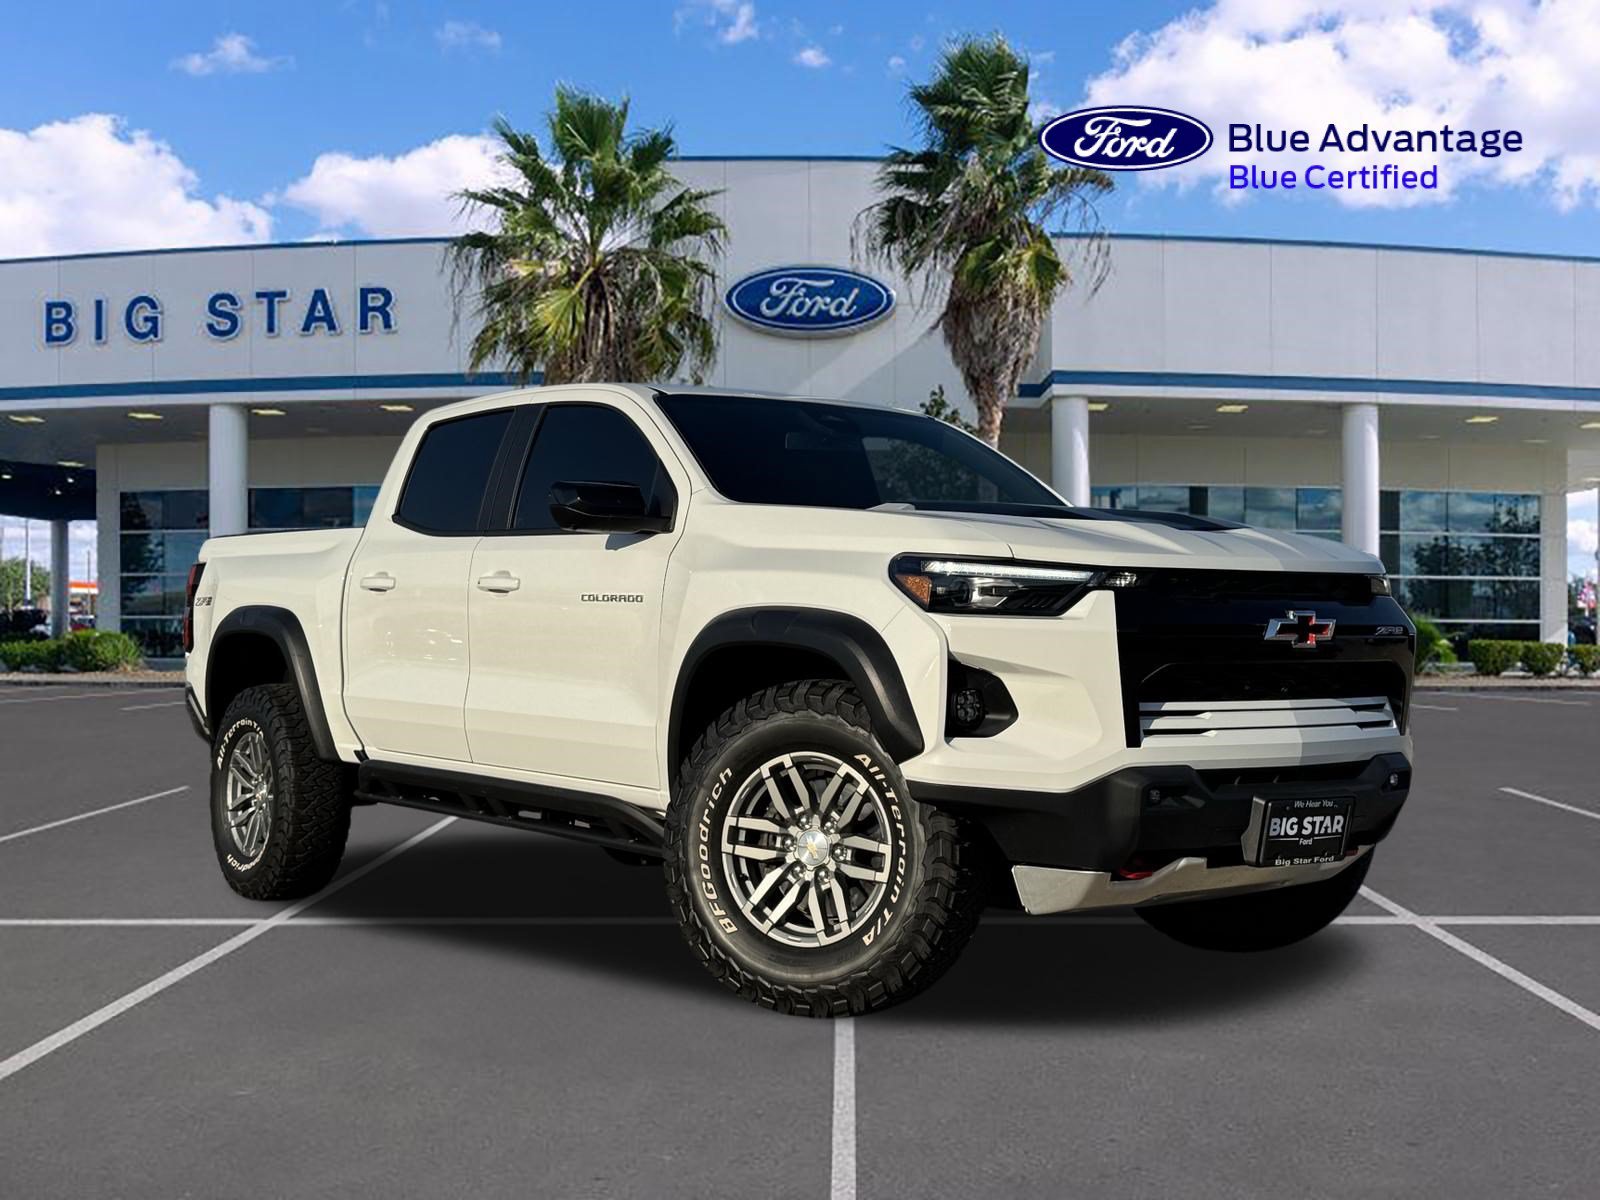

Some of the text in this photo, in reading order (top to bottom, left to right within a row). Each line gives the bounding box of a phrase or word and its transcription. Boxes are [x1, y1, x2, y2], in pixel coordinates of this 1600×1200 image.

[760, 277, 861, 318] Ford
[44, 286, 398, 345] BIG STAR
[580, 593, 644, 603] COLORADO
[1269, 815, 1344, 836] BIG STAR
[699, 768, 738, 934] BFGoodrich
[854, 753, 905, 946] All-Terrain T/A
[1299, 838, 1313, 846] Ford
[1275, 855, 1335, 867] Big Star Ford
